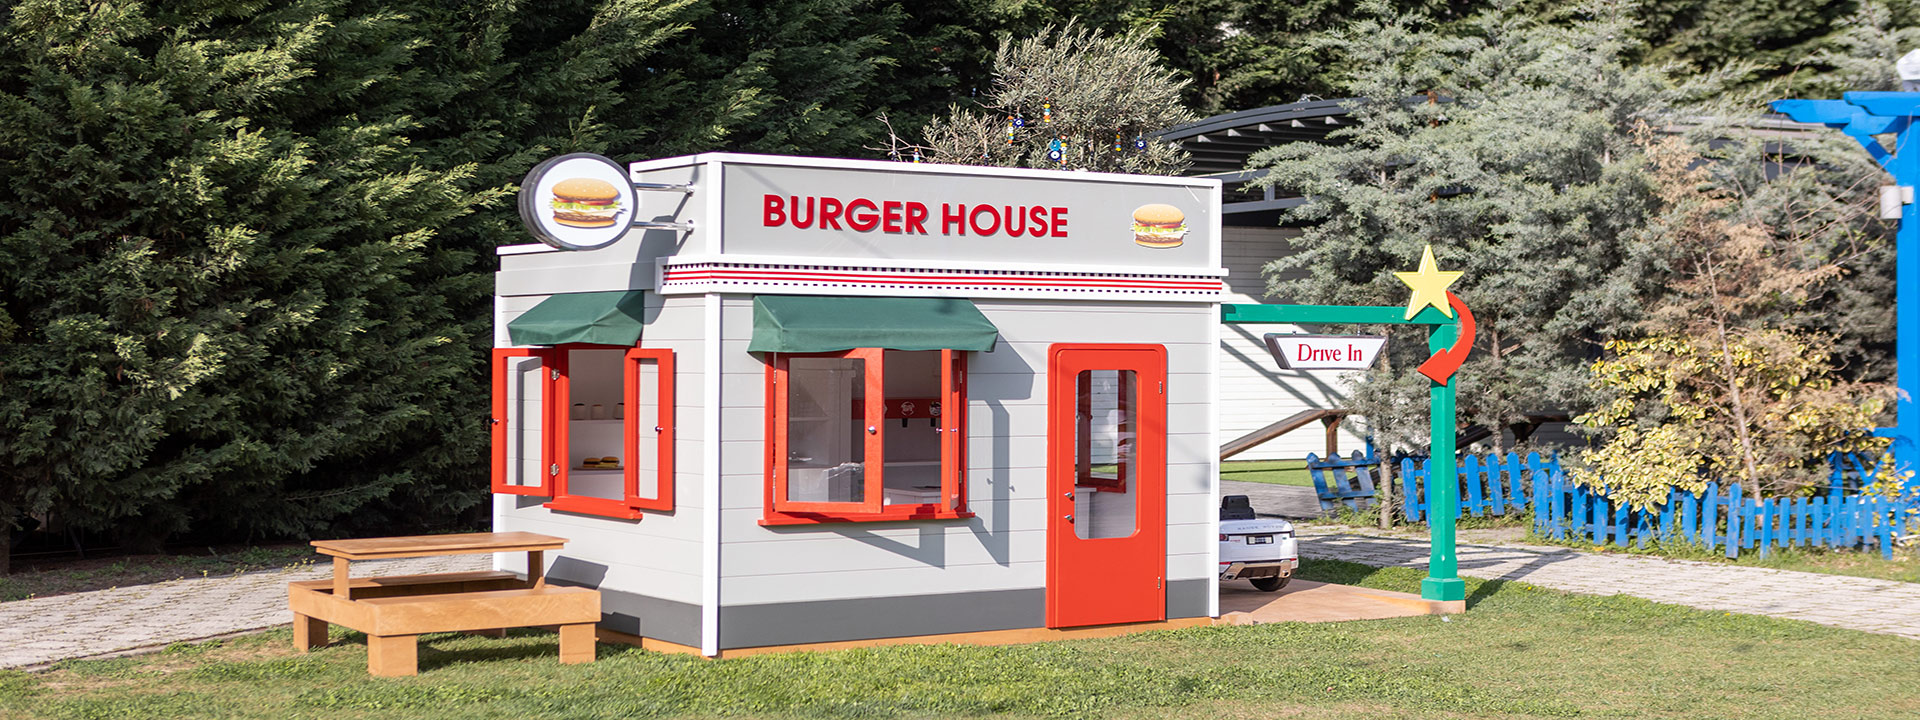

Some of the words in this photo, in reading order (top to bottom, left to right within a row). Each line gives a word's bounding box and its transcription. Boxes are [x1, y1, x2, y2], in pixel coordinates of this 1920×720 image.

[763, 194, 928, 235] BURGER
[942, 203, 1069, 238] HOUSE
[1297, 343, 1342, 362] Drive
[1347, 343, 1363, 362] In
